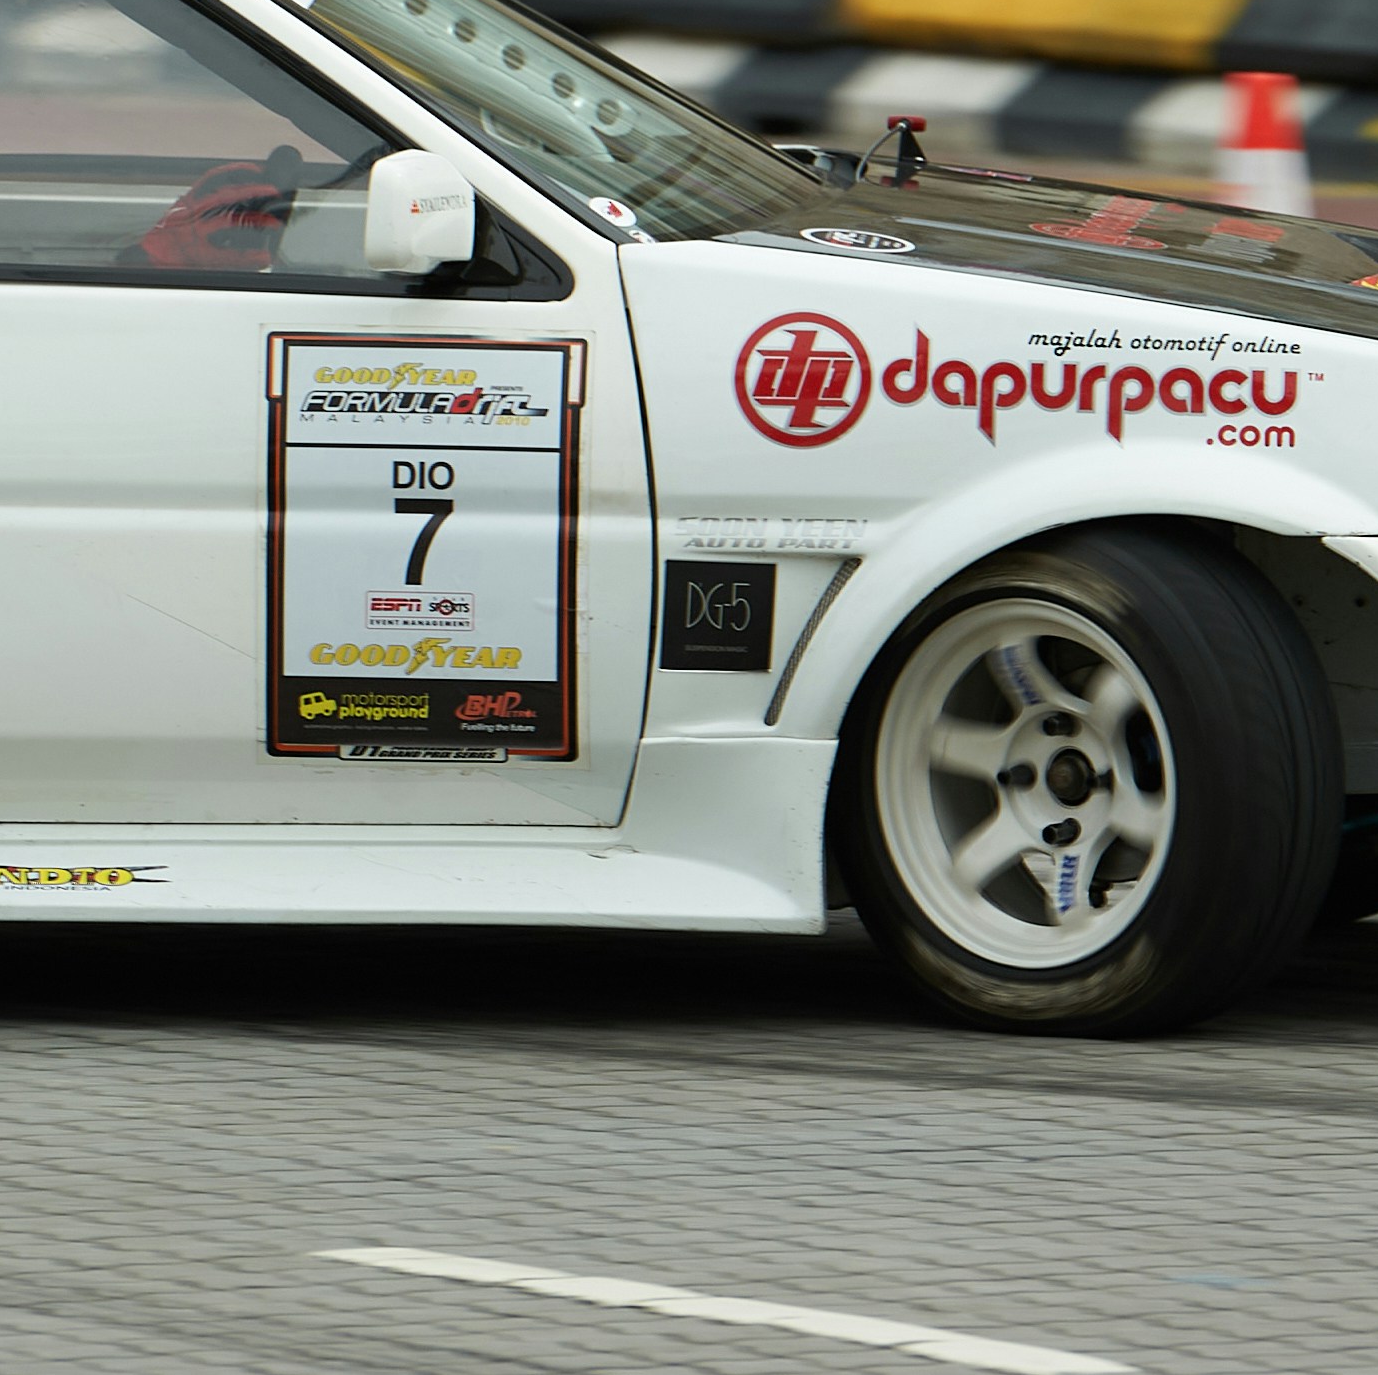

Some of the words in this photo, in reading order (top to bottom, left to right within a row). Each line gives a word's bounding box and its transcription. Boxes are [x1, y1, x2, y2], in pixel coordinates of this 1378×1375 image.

[1028, 328, 1122, 357] majalah
[1130, 333, 1229, 361] otomotif
[1231, 336, 1301, 355] online
[881, 325, 1297, 447] dapurpacu
[300, 413, 476, 425] MALAYSIA
[495, 416, 531, 426] 2010
[1206, 424, 1296, 448] .com
[392, 461, 455, 491] DIO
[675, 516, 768, 536] SOON
[781, 518, 869, 538] YEEN
[393, 498, 455, 587] 7
[683, 537, 767, 549] AUTO
[777, 538, 860, 550] PART
[370, 597, 422, 612] ESPN
[339, 692, 430, 707] motorsport
[338, 705, 429, 721] playground
[461, 722, 494, 732] Fuelling
[495, 723, 509, 731] the
[510, 724, 536, 732] future
[379, 749, 421, 758] GRAND
[422, 750, 450, 758] PRIX
[452, 751, 497, 759] SERIES
